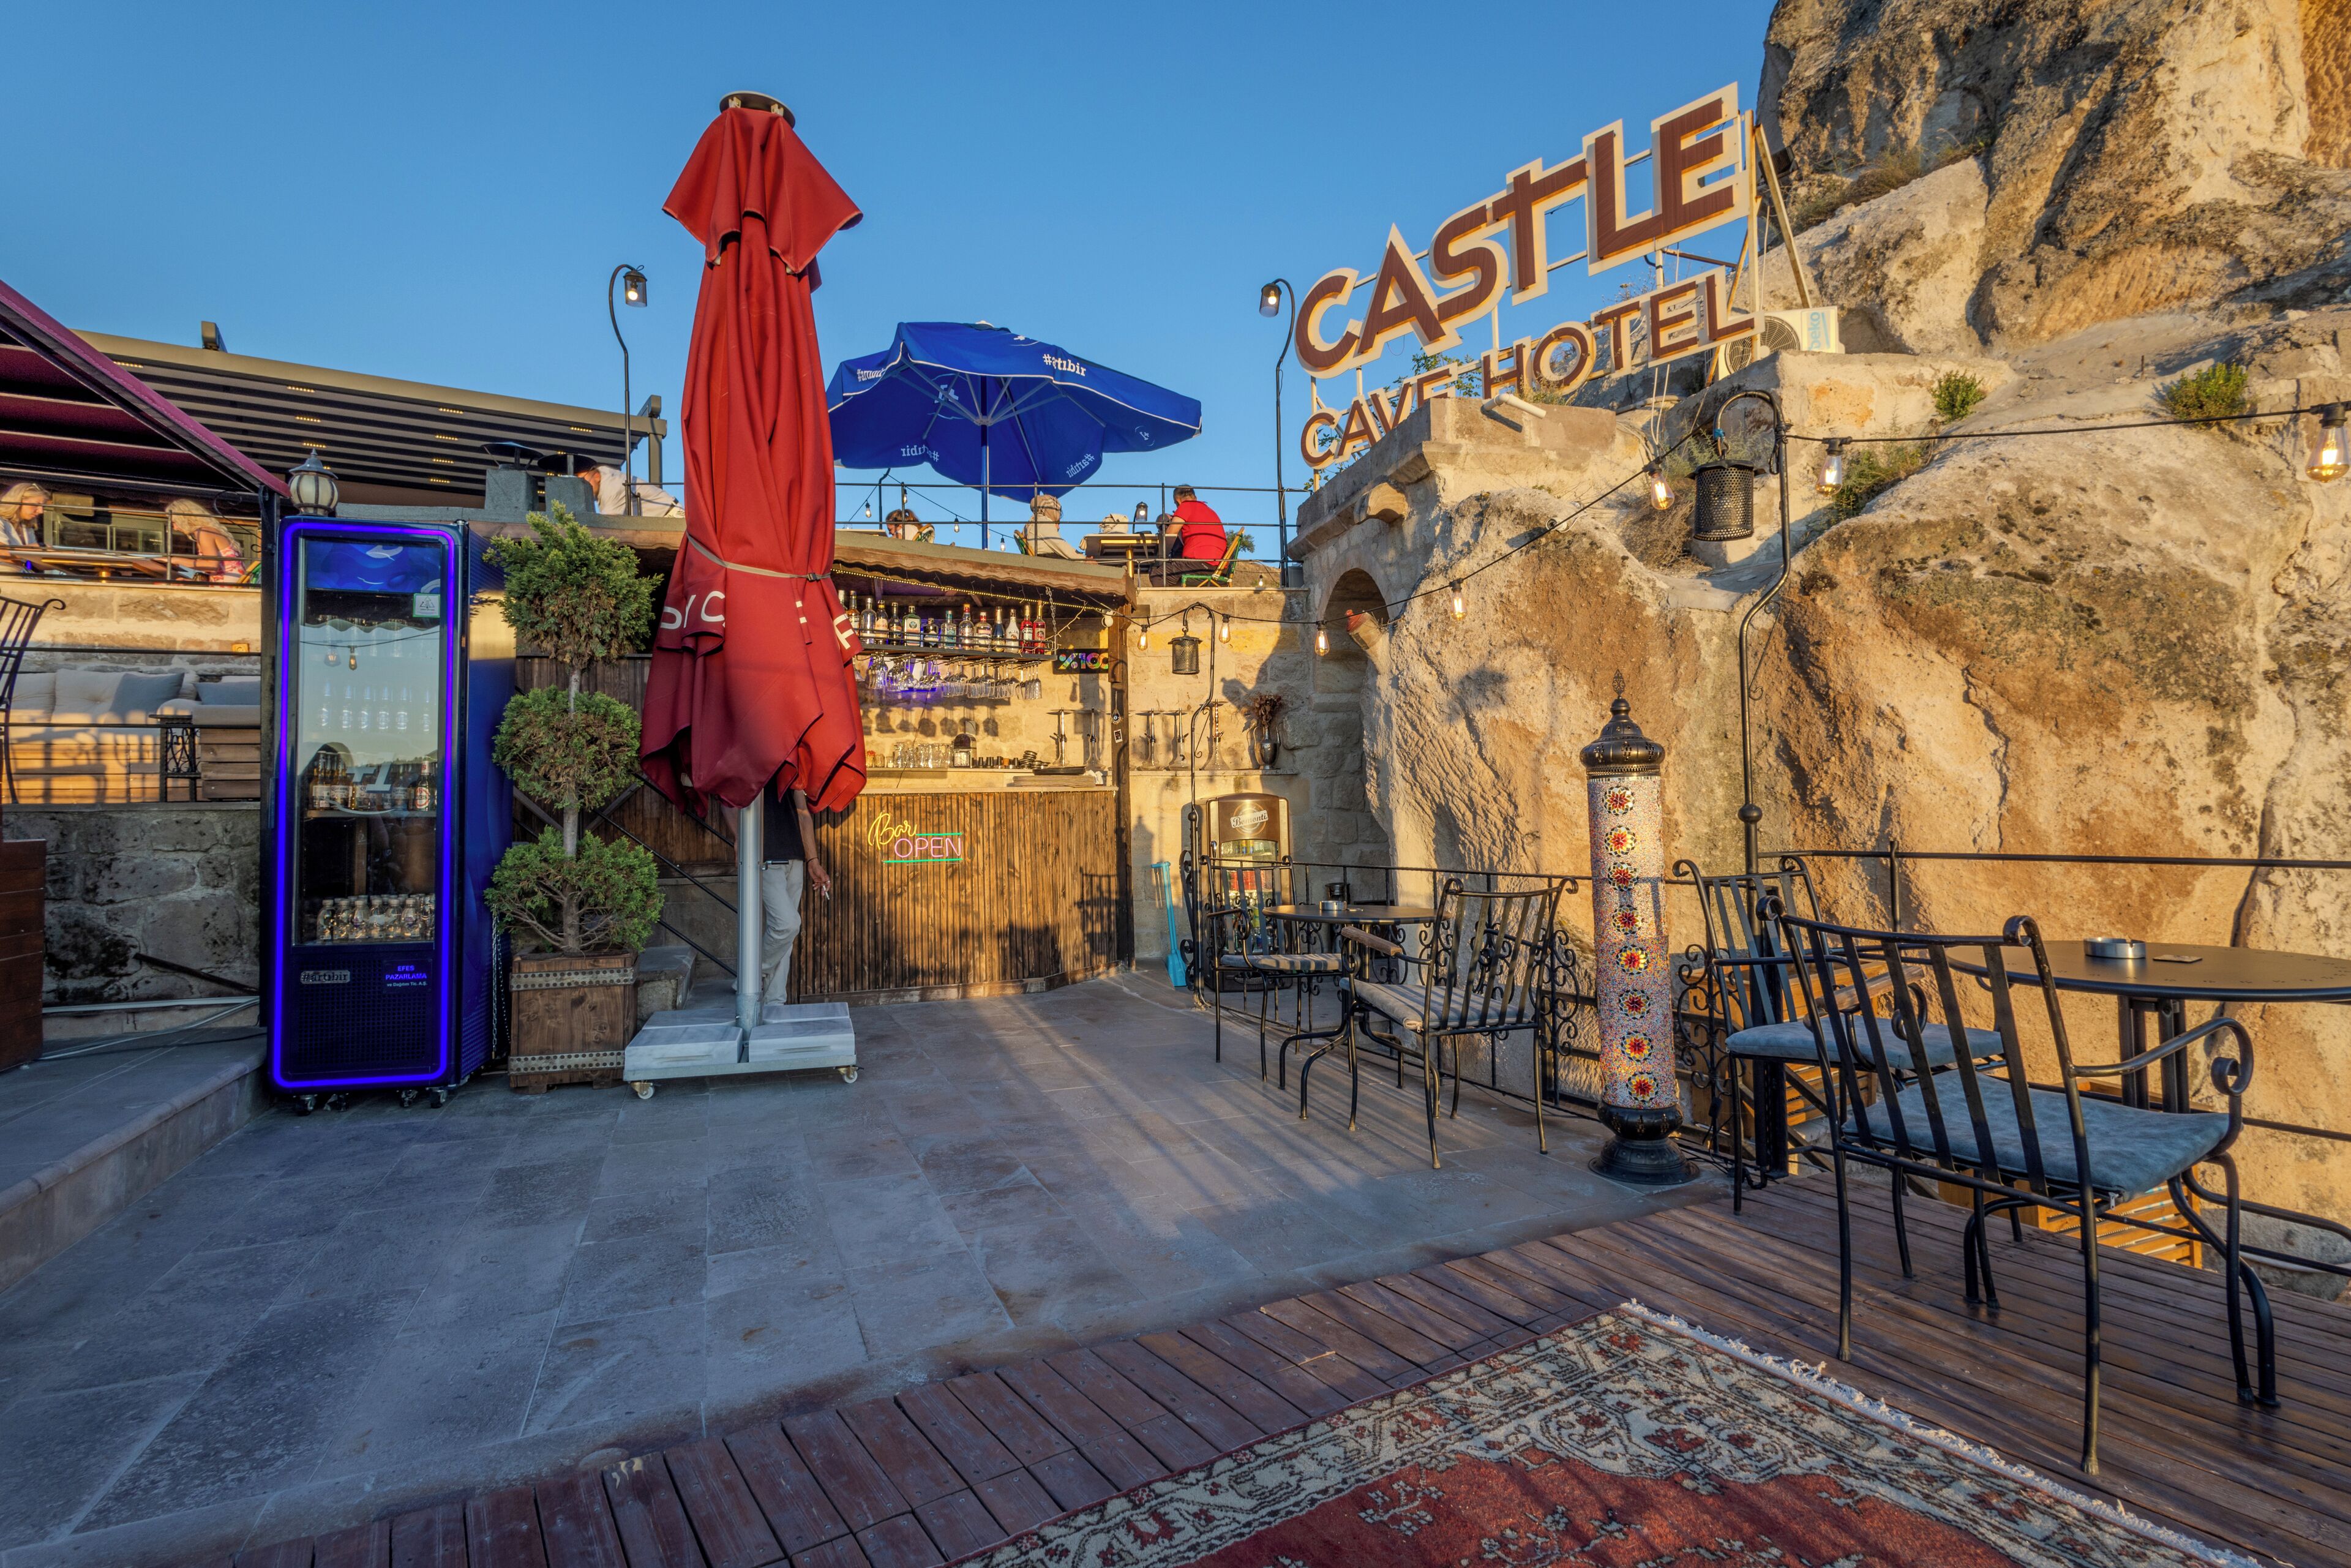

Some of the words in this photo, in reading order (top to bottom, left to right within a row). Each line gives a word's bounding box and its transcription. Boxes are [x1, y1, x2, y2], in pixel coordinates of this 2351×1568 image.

[1295, 83, 1749, 378] CASTLE
[1807, 312, 1821, 351] beko
[1300, 362, 1458, 470] CAVE
[1481, 266, 1764, 401] HOTEL
[868, 812, 917, 850] Bar
[1232, 812, 1267, 827] Bomonti
[894, 837, 961, 858] OPEN
